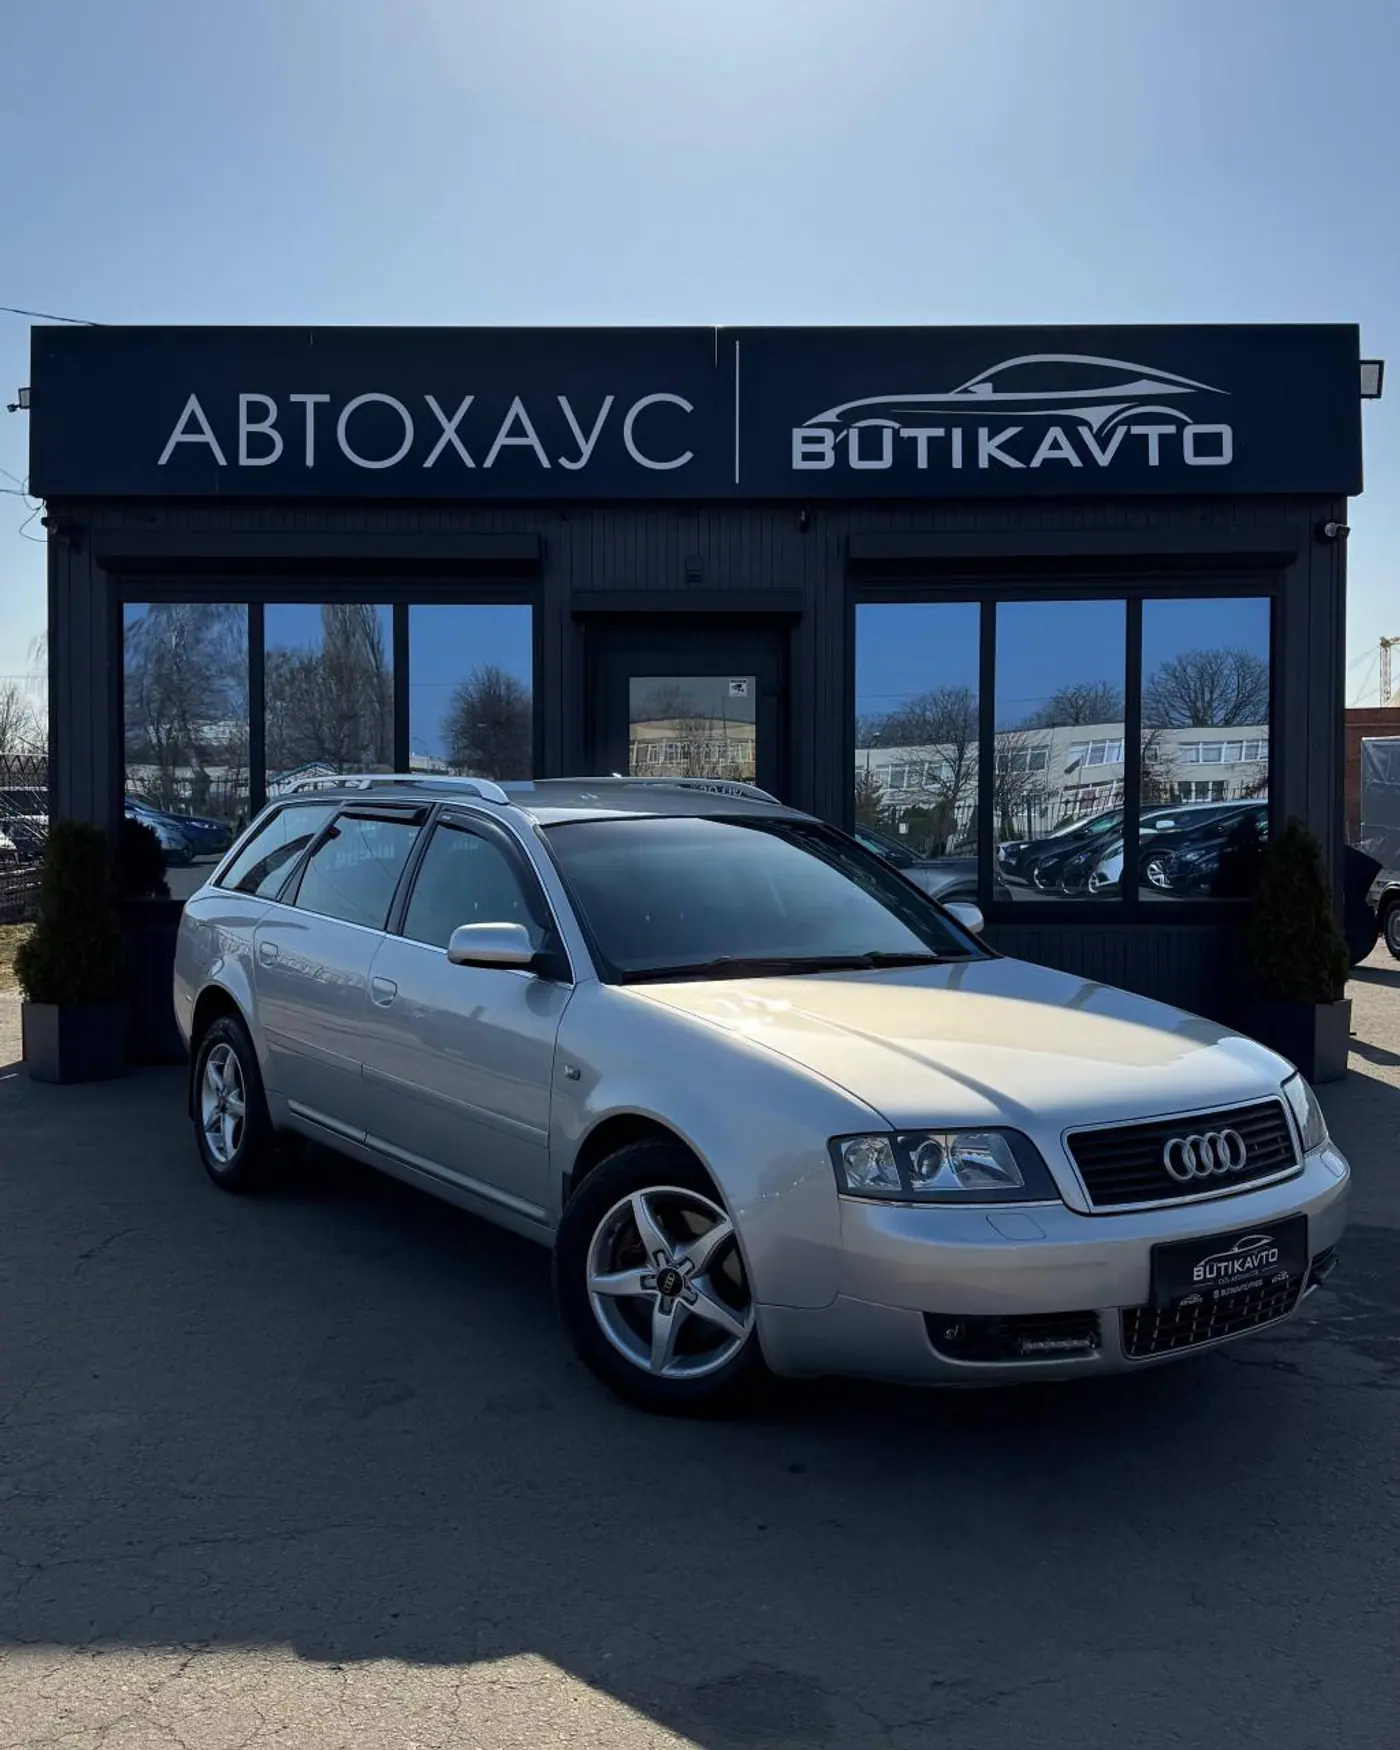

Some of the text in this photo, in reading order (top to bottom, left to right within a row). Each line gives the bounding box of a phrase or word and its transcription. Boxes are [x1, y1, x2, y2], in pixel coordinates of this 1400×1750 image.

[158, 393, 695, 470] АВТОХАУС
[792, 423, 1233, 469] BUTIKAVTO
[1193, 1248, 1279, 1281] BUTIKAVTO
